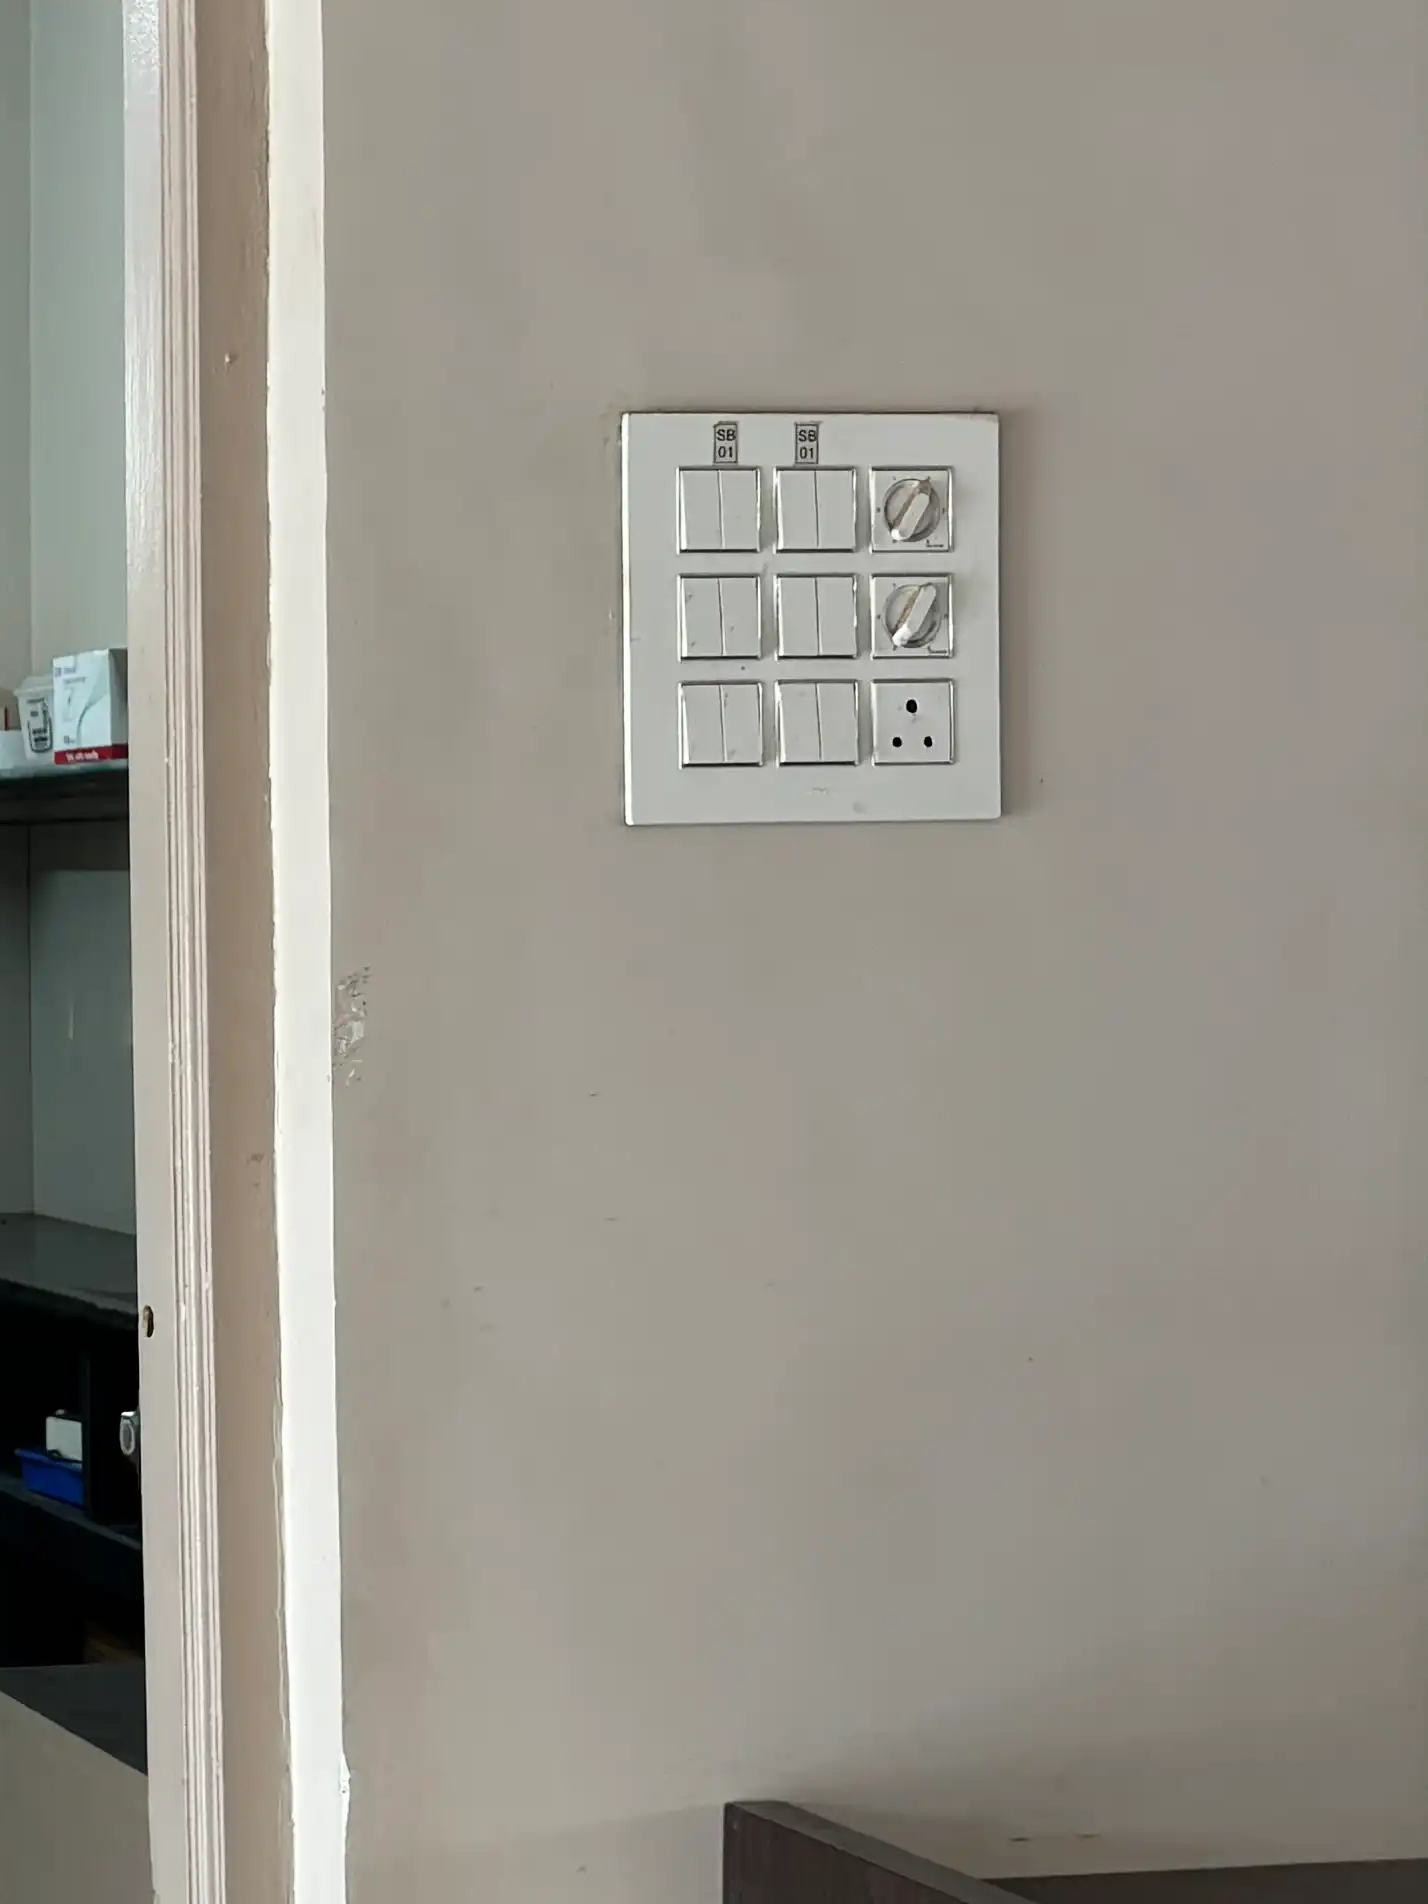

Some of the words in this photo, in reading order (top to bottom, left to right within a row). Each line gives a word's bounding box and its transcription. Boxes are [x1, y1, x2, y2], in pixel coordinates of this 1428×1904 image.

[716, 428, 736, 441] SB
[798, 429, 817, 442] SB
[718, 445, 732, 457] 01
[800, 446, 814, 458] 01
